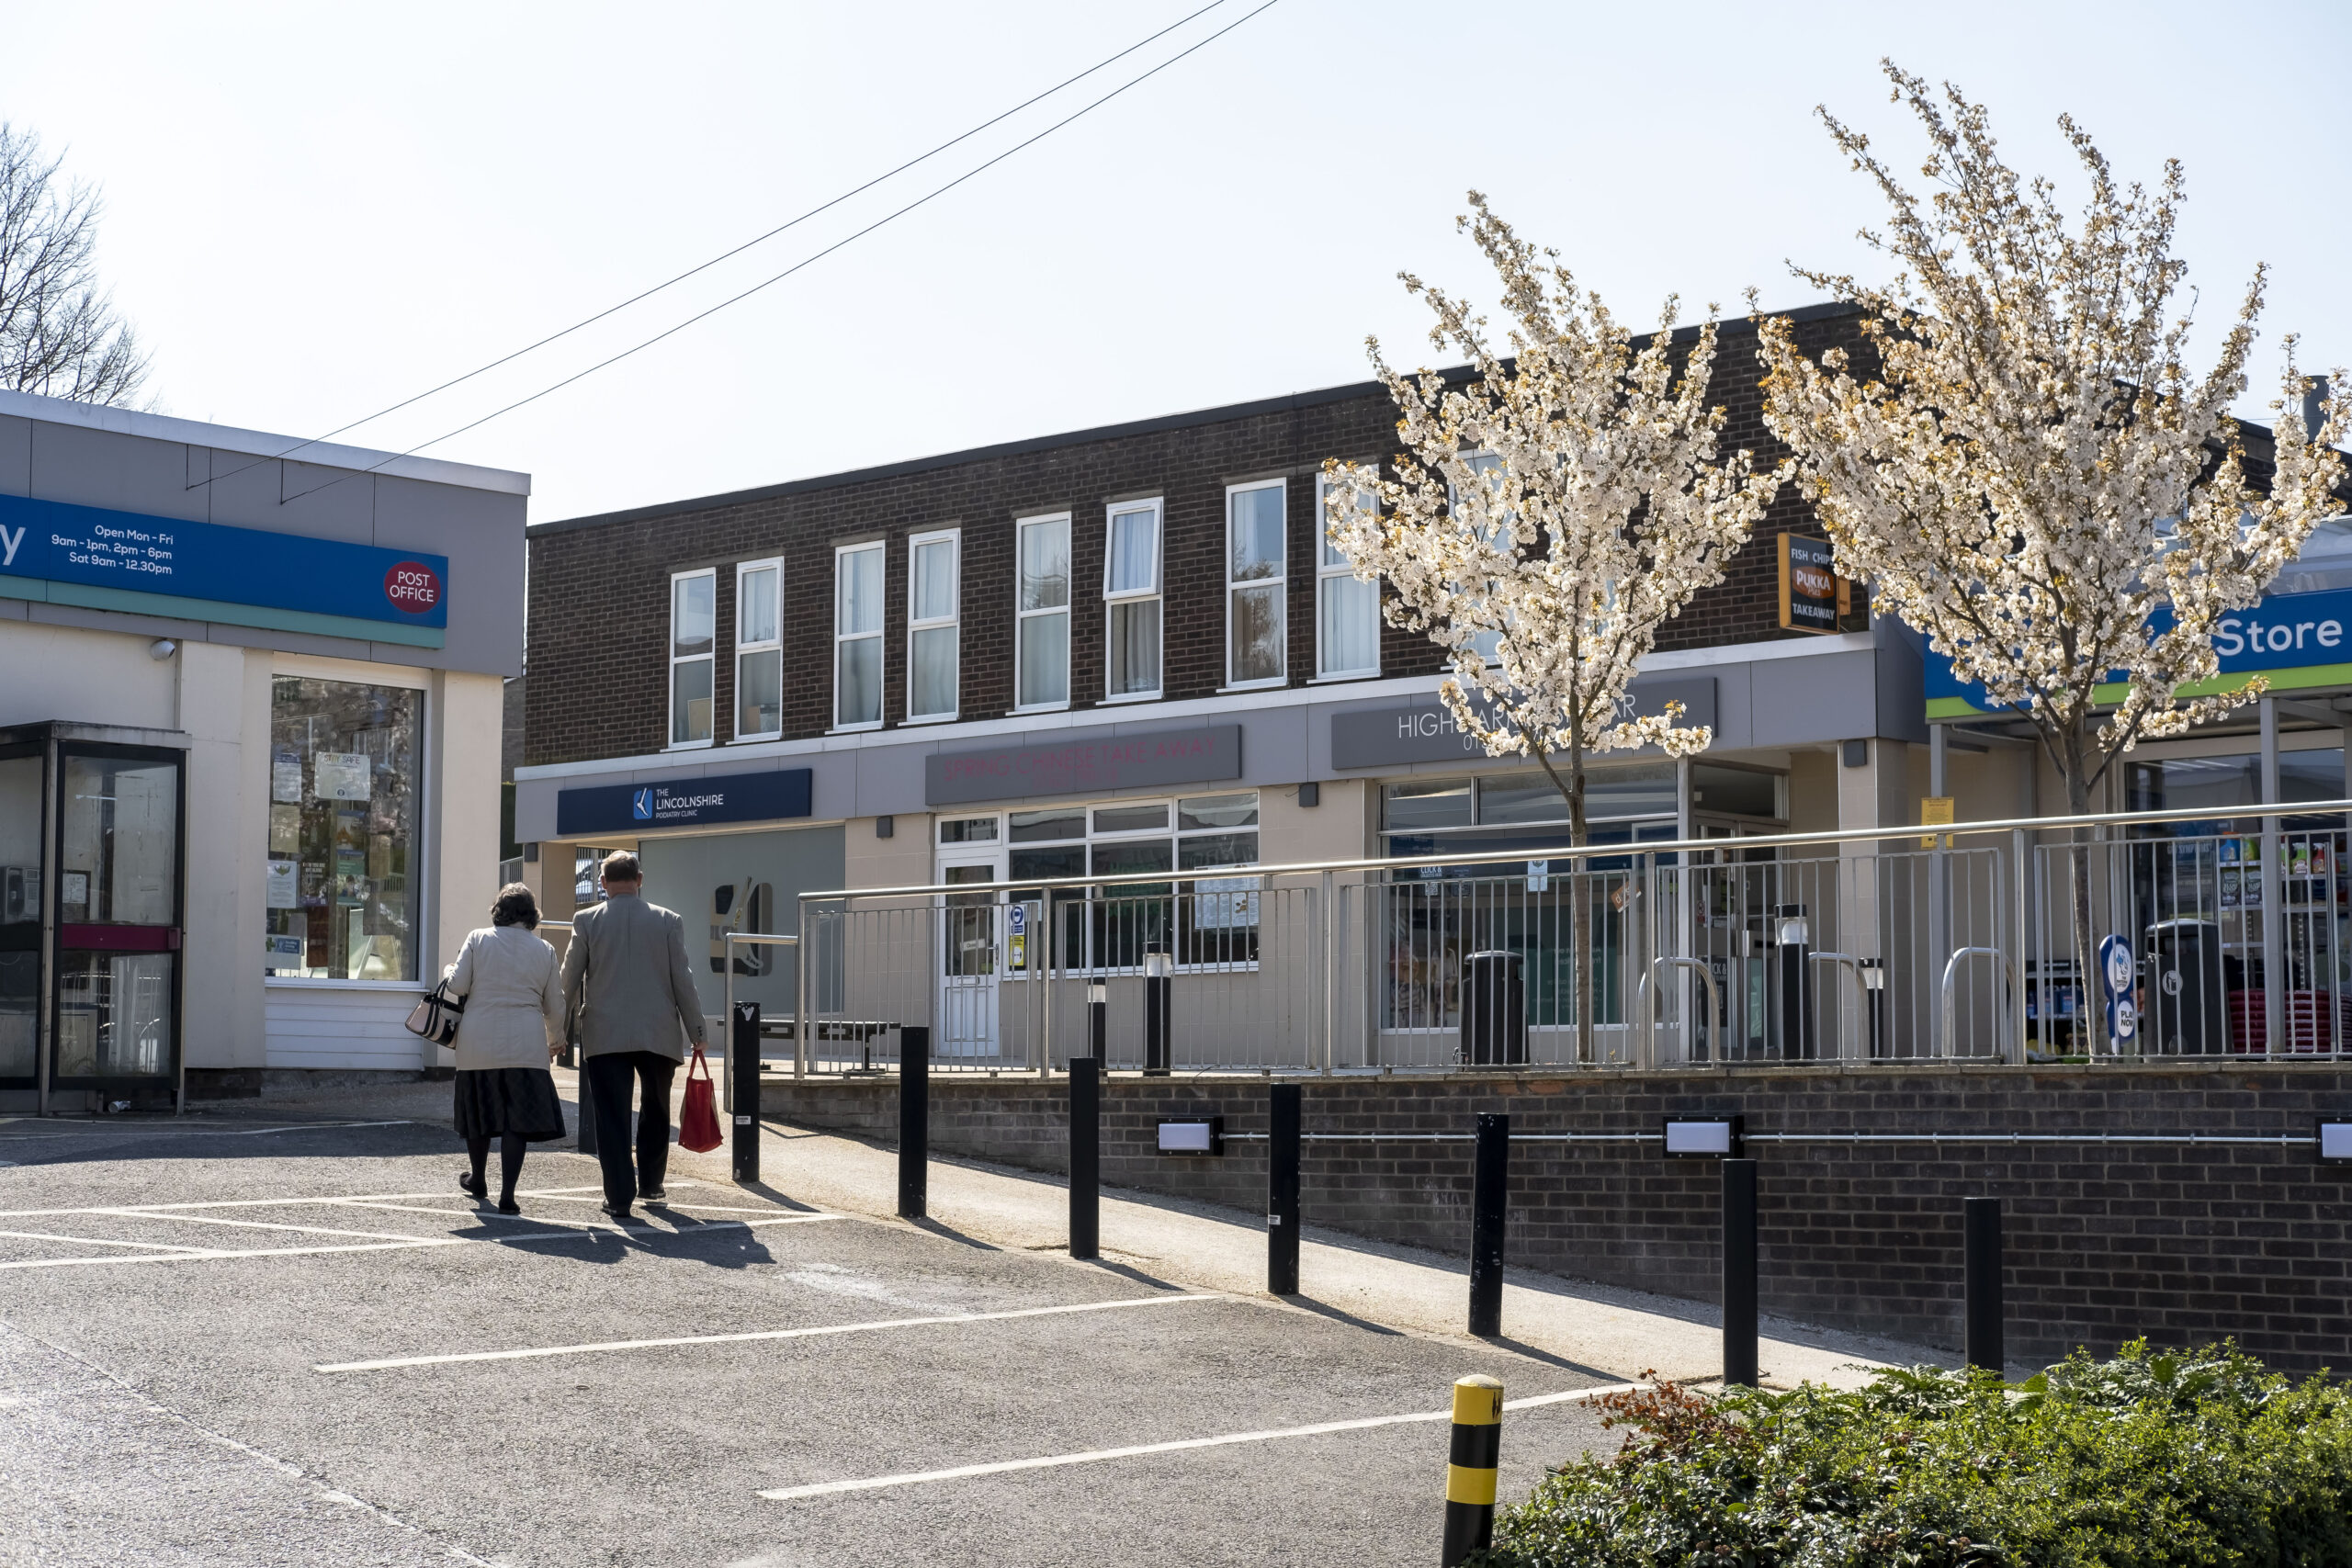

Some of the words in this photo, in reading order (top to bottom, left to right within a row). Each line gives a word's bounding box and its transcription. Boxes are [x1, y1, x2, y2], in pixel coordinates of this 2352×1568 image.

[95, 525, 124, 540] Open
[127, 529, 149, 542] Mon
[159, 533, 174, 545] Fri
[51, 534, 77, 547] 9am
[86, 538, 112, 554] 1pm,
[113, 544, 139, 558] 2pm
[147, 547, 173, 561] 6pm
[1791, 547, 1809, 562] FISH
[69, 551, 89, 565] Sat
[91, 555, 117, 568] 9am
[125, 558, 173, 576] 12.30pm
[397, 570, 431, 587] POST
[1796, 570, 1831, 591] PUKKA
[390, 585, 434, 603] OFFICE
[1807, 585, 1821, 597] Pies
[1792, 603, 1836, 621] TAKEAWAY
[2216, 618, 2343, 657] Store
[323, 754, 341, 762] STAY
[343, 756, 361, 764] SAFE
[943, 755, 1010, 782] SPRING
[1015, 746, 1096, 774] CHINESE
[1101, 741, 1148, 764] TAKE
[1153, 737, 1216, 760] AWAY
[656, 788, 669, 796] THE
[656, 794, 724, 810] LINCOLNSHIRE
[656, 810, 681, 818] PODIATRY
[681, 809, 697, 818] CLINIC
[2120, 1010, 2133, 1019] PLA
